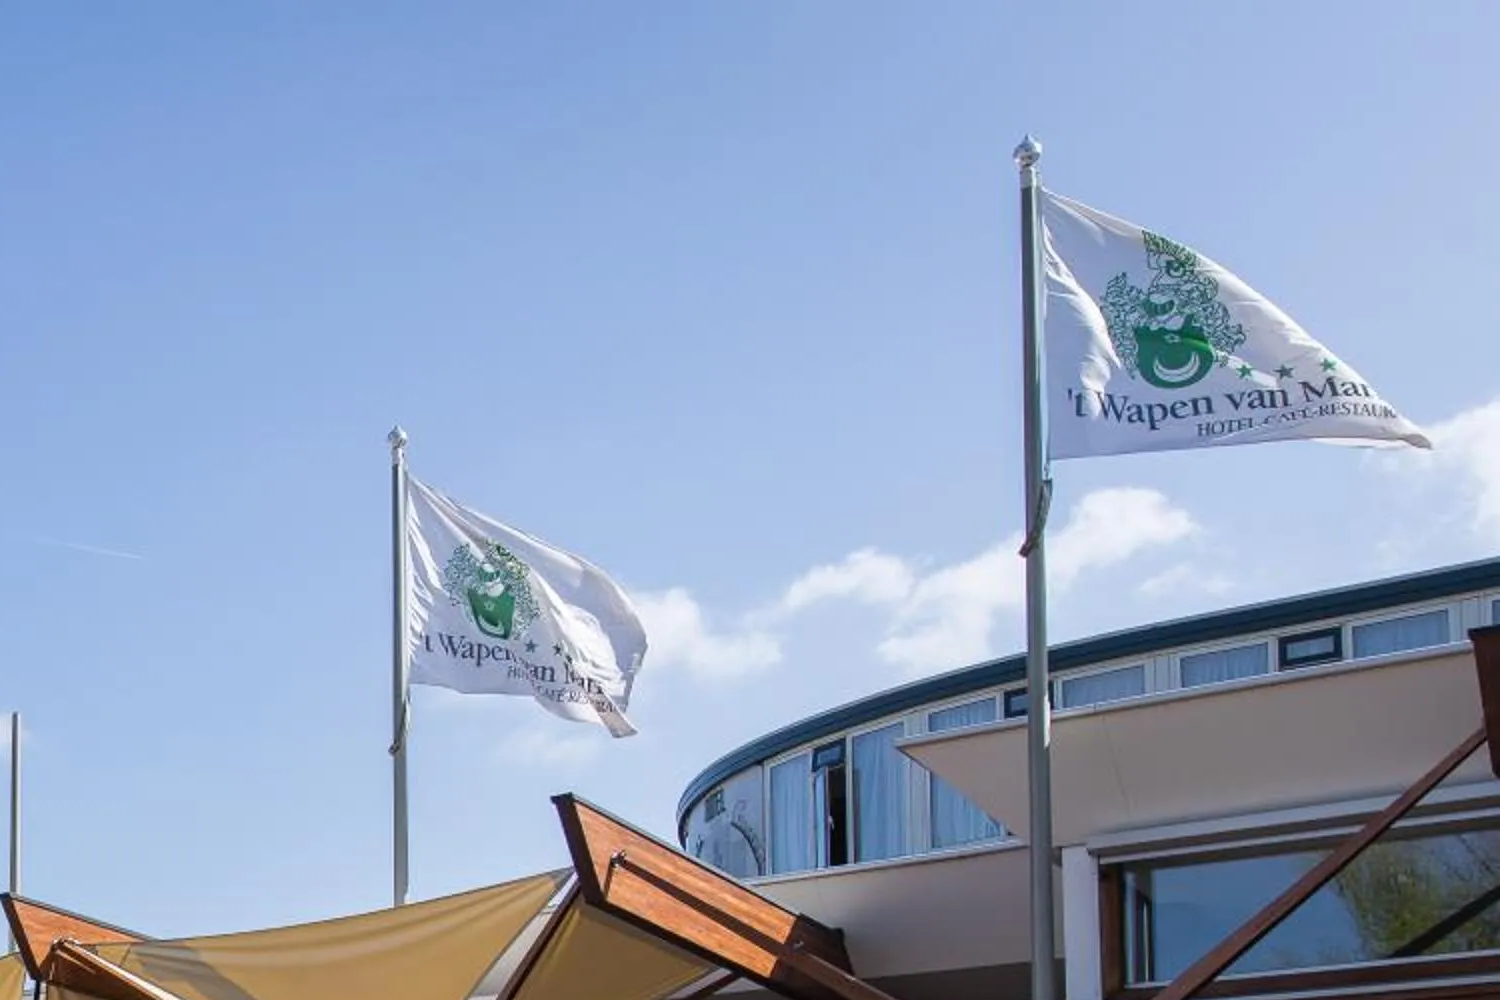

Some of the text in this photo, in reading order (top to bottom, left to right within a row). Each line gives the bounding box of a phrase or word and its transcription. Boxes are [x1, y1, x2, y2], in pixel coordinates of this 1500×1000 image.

[1067, 388, 1088, 418] 't
[1095, 390, 1216, 431] Wapen
[1224, 386, 1292, 411] van
